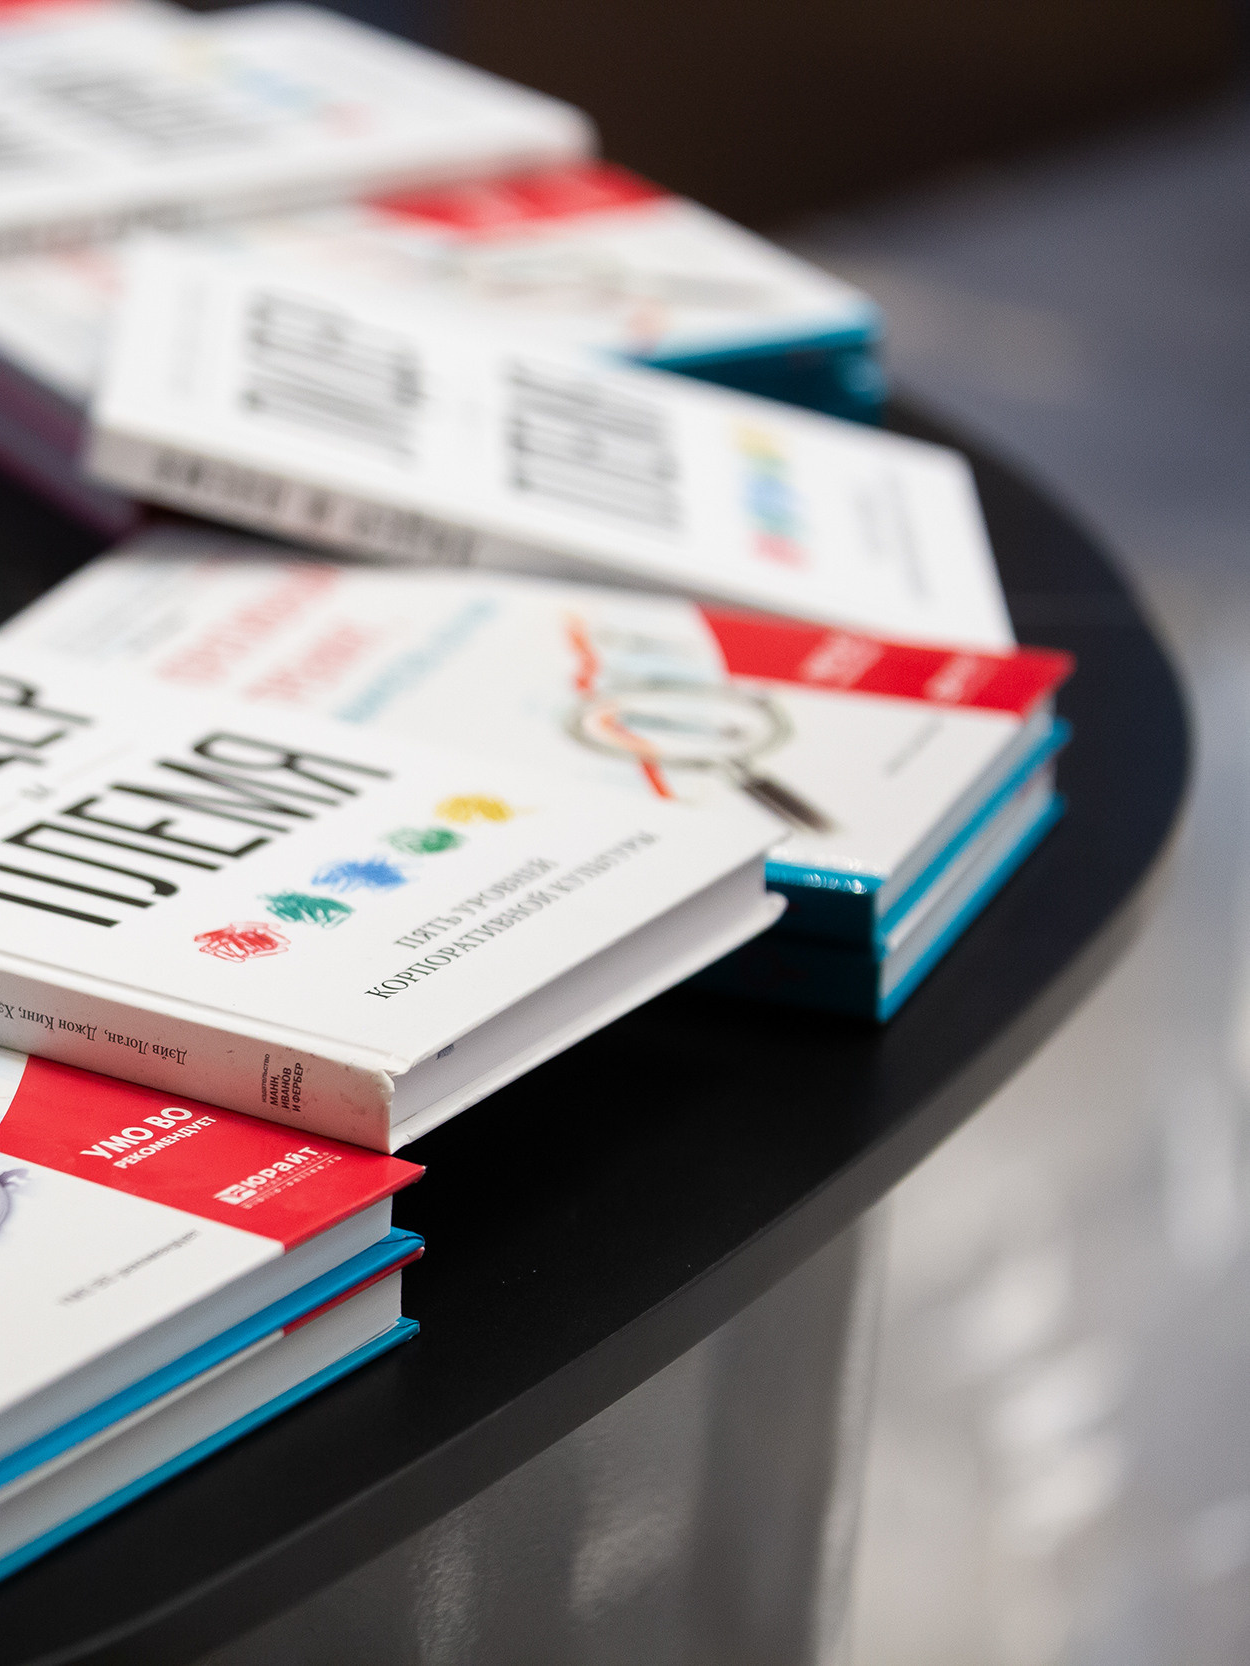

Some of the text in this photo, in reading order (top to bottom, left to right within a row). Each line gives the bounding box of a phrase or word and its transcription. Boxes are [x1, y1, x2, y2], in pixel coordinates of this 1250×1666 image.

[364, 889, 556, 1000] КОРПОРАТИВНОЙ
[393, 908, 463, 949] ПЯТЬ
[17, 1006, 55, 1030] Кинг,
[58, 1019, 98, 1042] Джон
[104, 1029, 149, 1055] Логан,
[152, 1043, 187, 1065] Дэйв
[270, 1074, 281, 1106] МАНН,
[281, 1067, 292, 1109] ИВАНОВ
[292, 1062, 304, 1112] И ФЕРБЕР
[80, 1107, 193, 1159] УМО ВО
[113, 1115, 217, 1169] РЕКОМЕНДУЕТ
